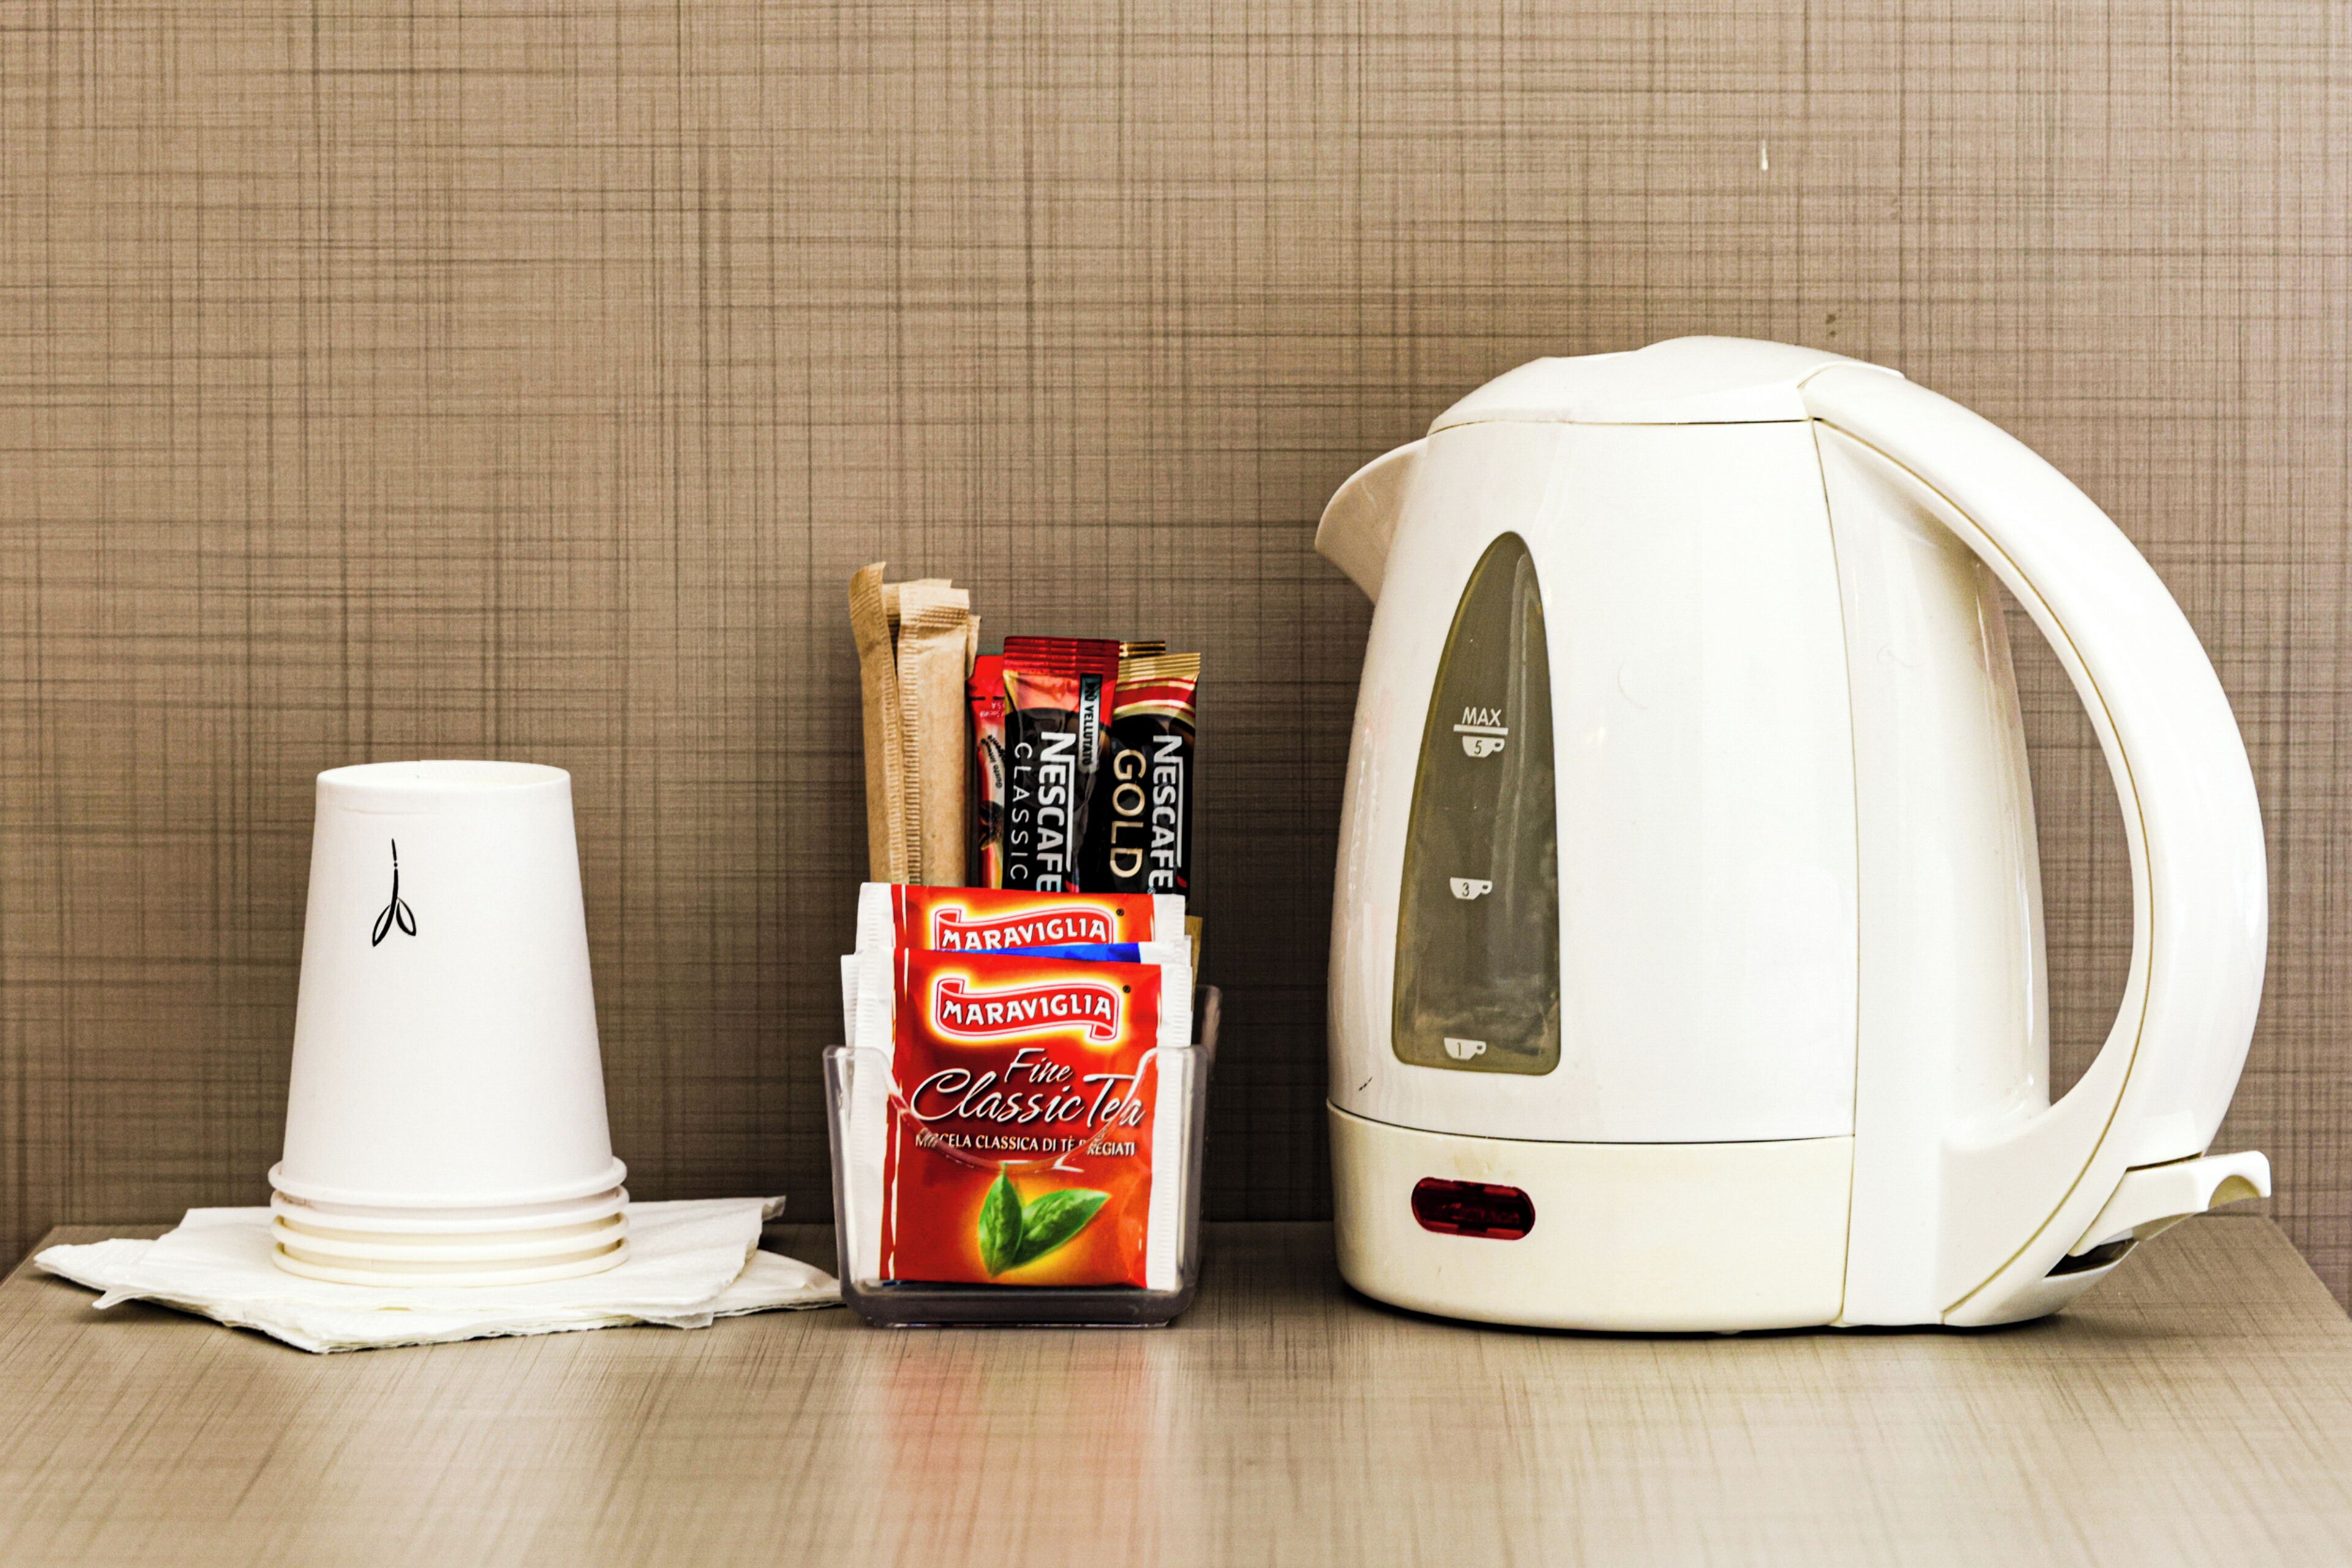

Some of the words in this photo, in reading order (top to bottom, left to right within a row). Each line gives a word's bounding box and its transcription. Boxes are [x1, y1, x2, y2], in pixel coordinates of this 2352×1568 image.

[1461, 706, 1502, 728] MAX
[1082, 705, 1094, 766] VELLUTATO
[1474, 739, 1482, 755] 5
[1011, 742, 1033, 880] CLASSIC
[1110, 749, 1146, 878] GOLD
[1462, 882, 1469, 897] 3
[941, 918, 1107, 950] MARAVIGLIA
[943, 994, 1111, 1025] MARAVIGLIA
[1004, 1047, 1074, 1084] Fine
[911, 1068, 1085, 1123] Classic
[1083, 1074, 1145, 1127] Tea
[975, 1134, 1039, 1152] CLASSICA
[1042, 1137, 1057, 1153] DI
